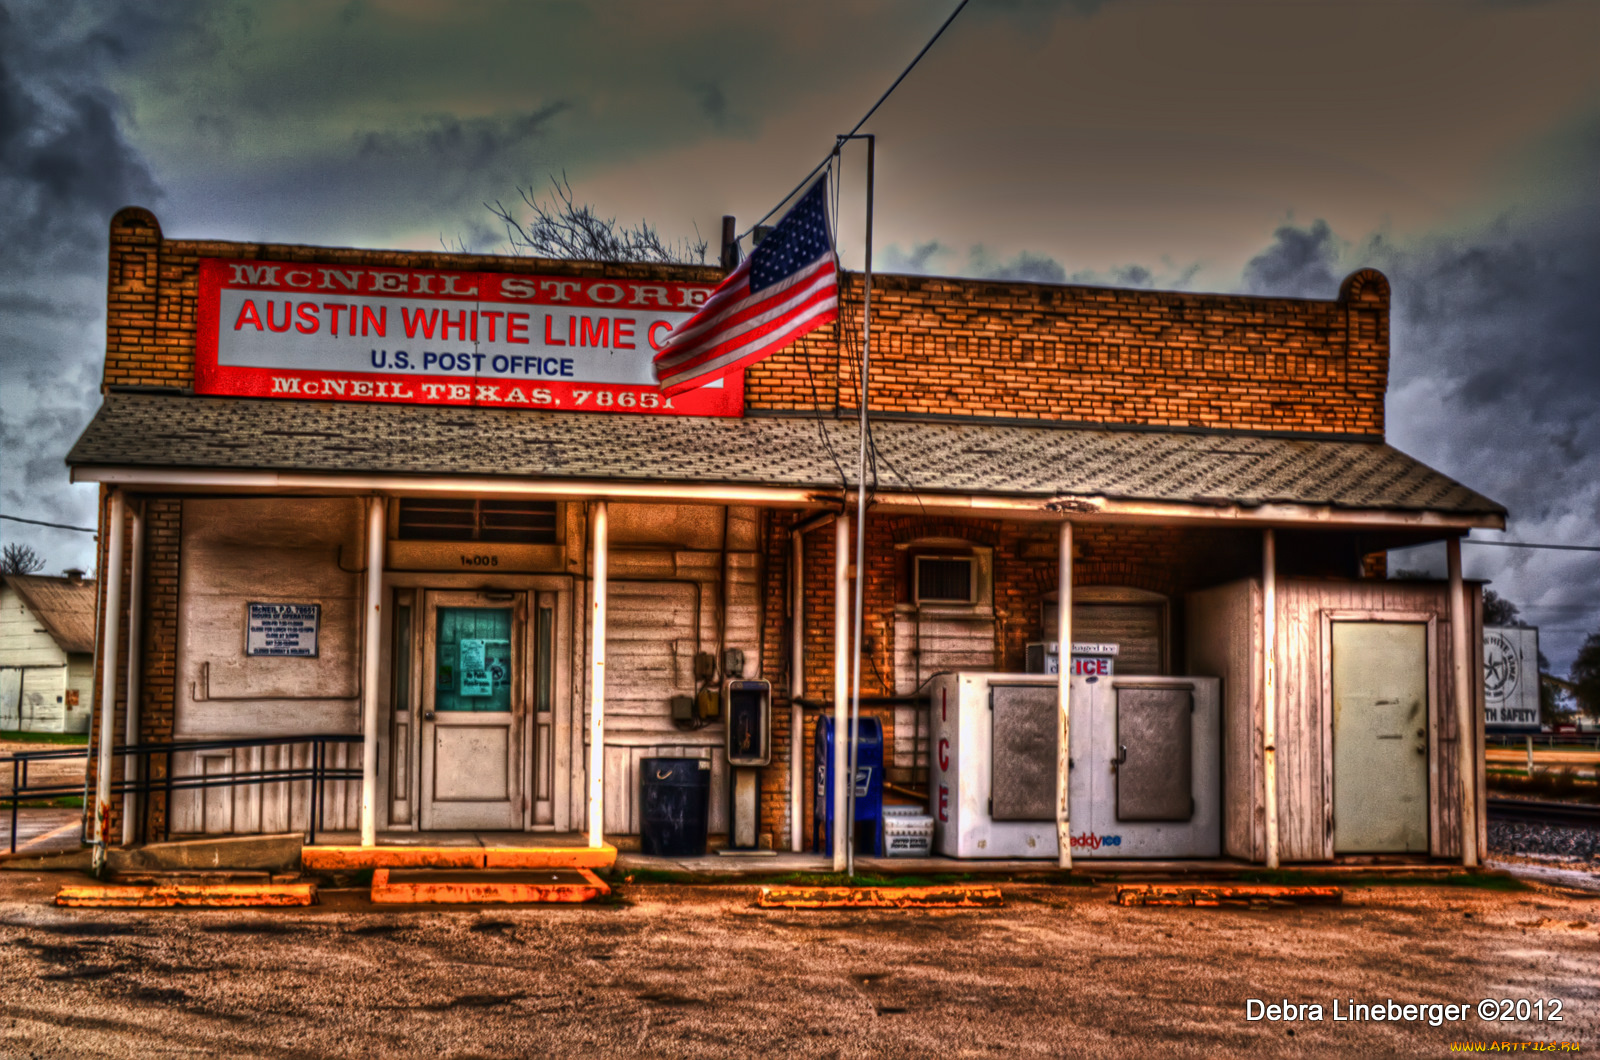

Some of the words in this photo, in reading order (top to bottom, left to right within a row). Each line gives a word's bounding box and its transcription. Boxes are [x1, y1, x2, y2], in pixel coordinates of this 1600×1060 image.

[229, 264, 479, 296] McNEIL
[500, 278, 715, 308] STORE
[234, 299, 387, 338] AUSTIN
[401, 307, 530, 345] WHITE
[545, 314, 636, 350] LIME
[648, 320, 674, 351] C
[371, 349, 416, 370] U.S.
[423, 352, 486, 373] POST
[492, 355, 575, 377] OFFICE
[271, 376, 413, 399] McNEIL
[422, 383, 561, 408] TEXAS,
[572, 390, 675, 410] 78651
[1076, 659, 1109, 675] ICE
[1500, 708, 1537, 722] SAFETY
[938, 686, 950, 823] ICE
[1070, 832, 1122, 850] eddyice
